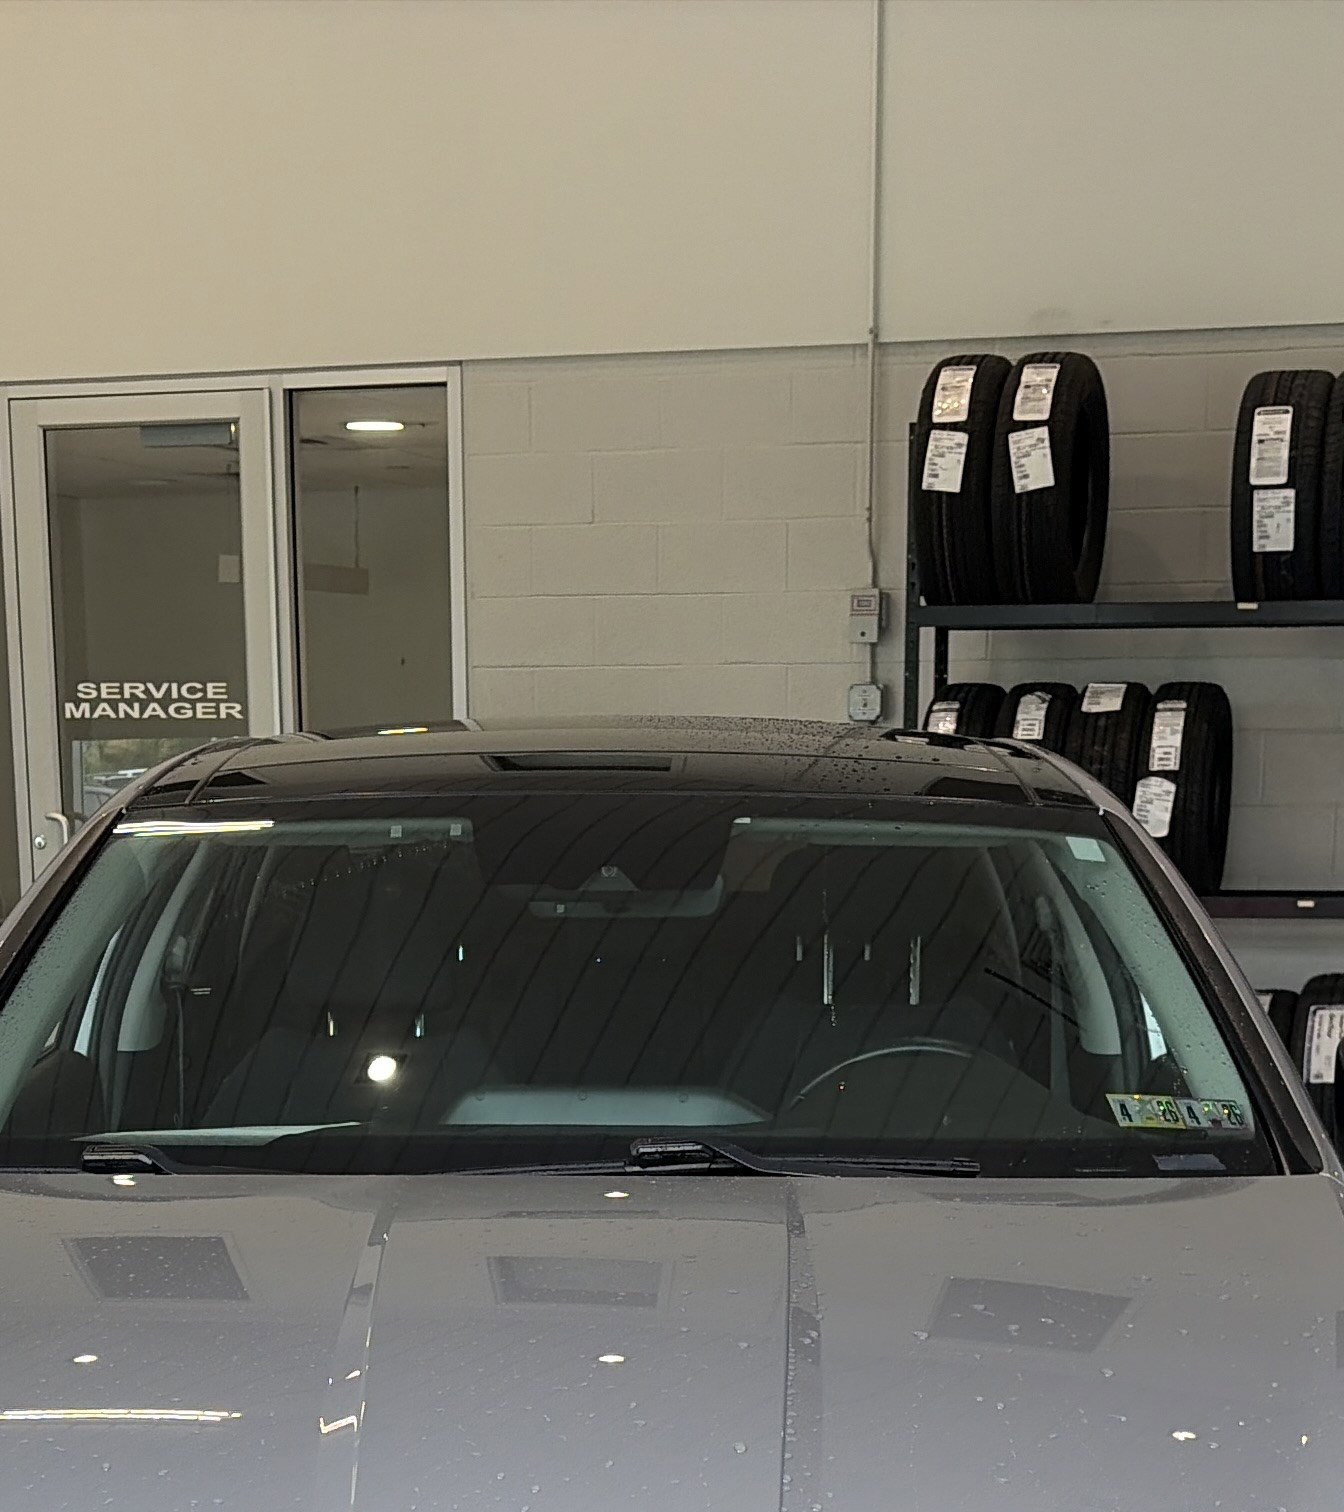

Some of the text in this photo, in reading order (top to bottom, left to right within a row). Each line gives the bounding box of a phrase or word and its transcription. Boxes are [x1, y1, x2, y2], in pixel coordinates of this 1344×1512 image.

[76, 682, 228, 699] SERVICE
[64, 702, 244, 719] MANAGER
[1118, 1102, 1134, 1123] 4
[1185, 1105, 1202, 1126] 4
